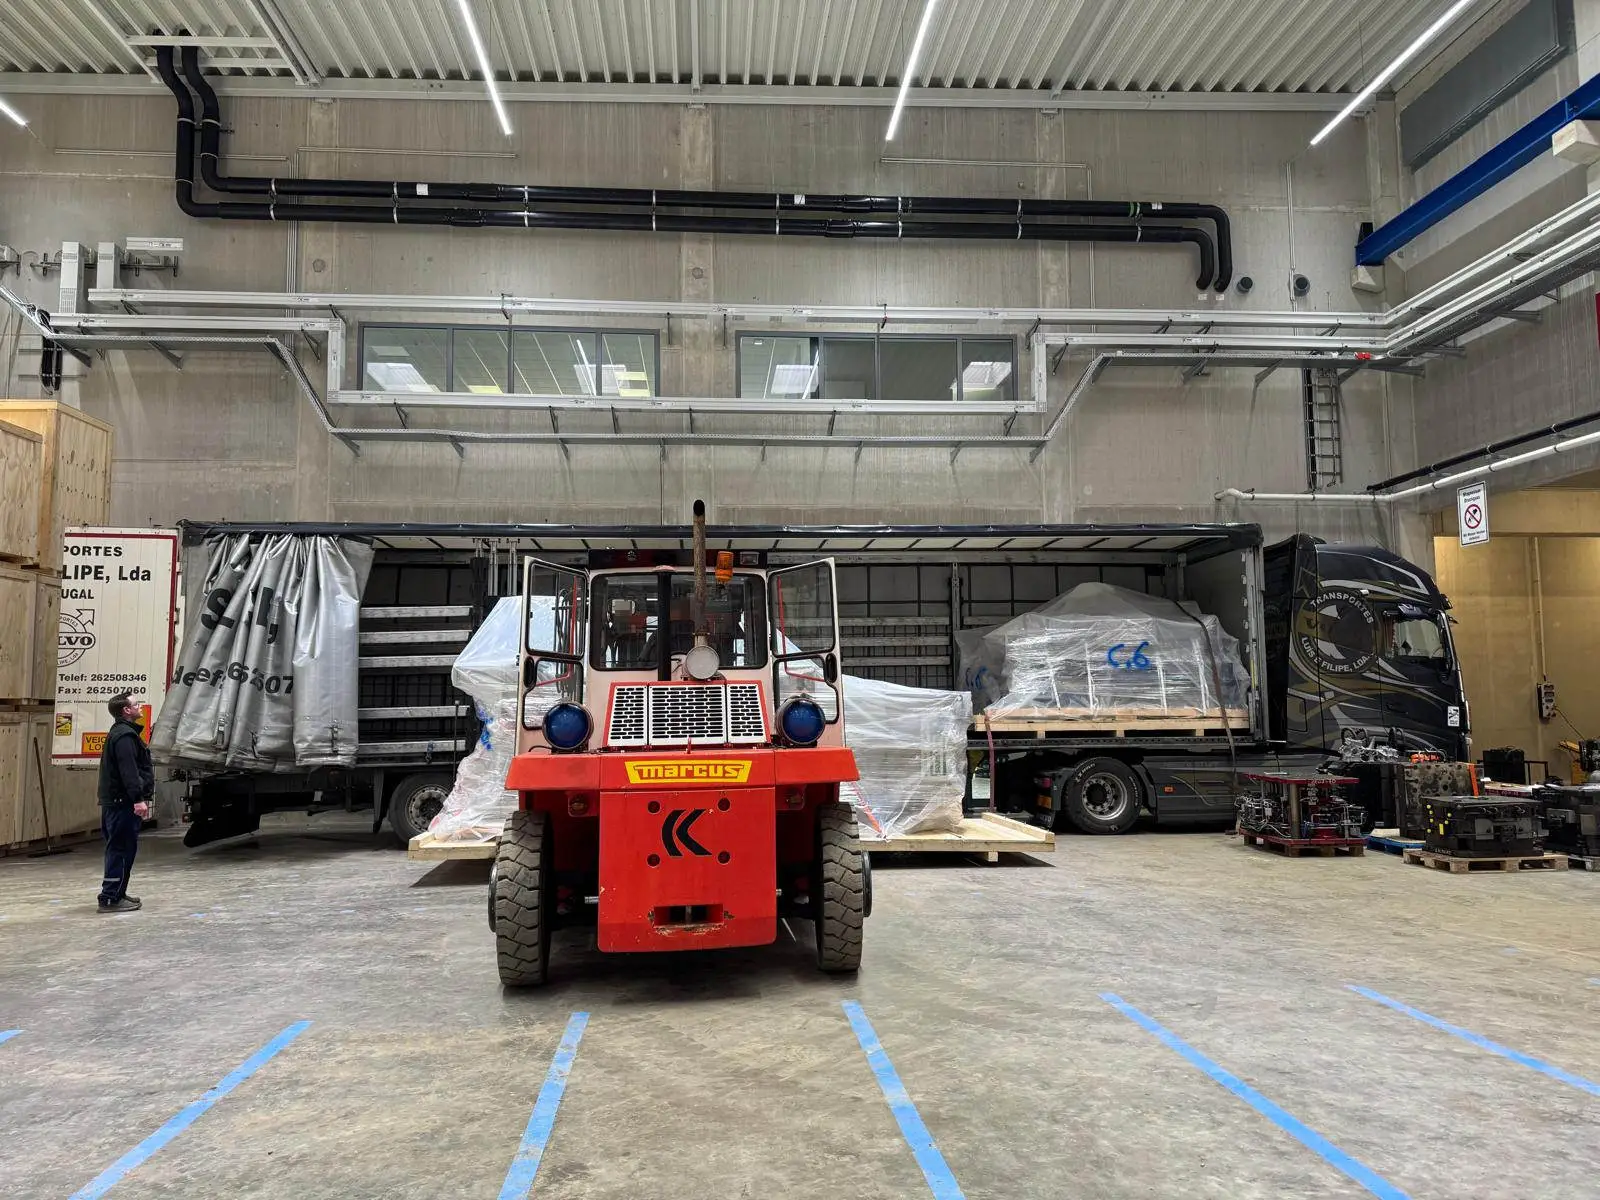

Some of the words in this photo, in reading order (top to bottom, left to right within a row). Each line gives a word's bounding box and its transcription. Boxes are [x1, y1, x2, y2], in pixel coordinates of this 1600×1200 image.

[62, 565, 110, 583] LIPE,
[118, 565, 151, 581] Lda
[61, 588, 95, 600] UGAL
[1310, 592, 1374, 624] TRANSPORTES
[58, 673, 88, 682] Telef:
[90, 673, 147, 682] 262508346
[58, 686, 82, 694] Fax:
[86, 686, 147, 695] 262507060
